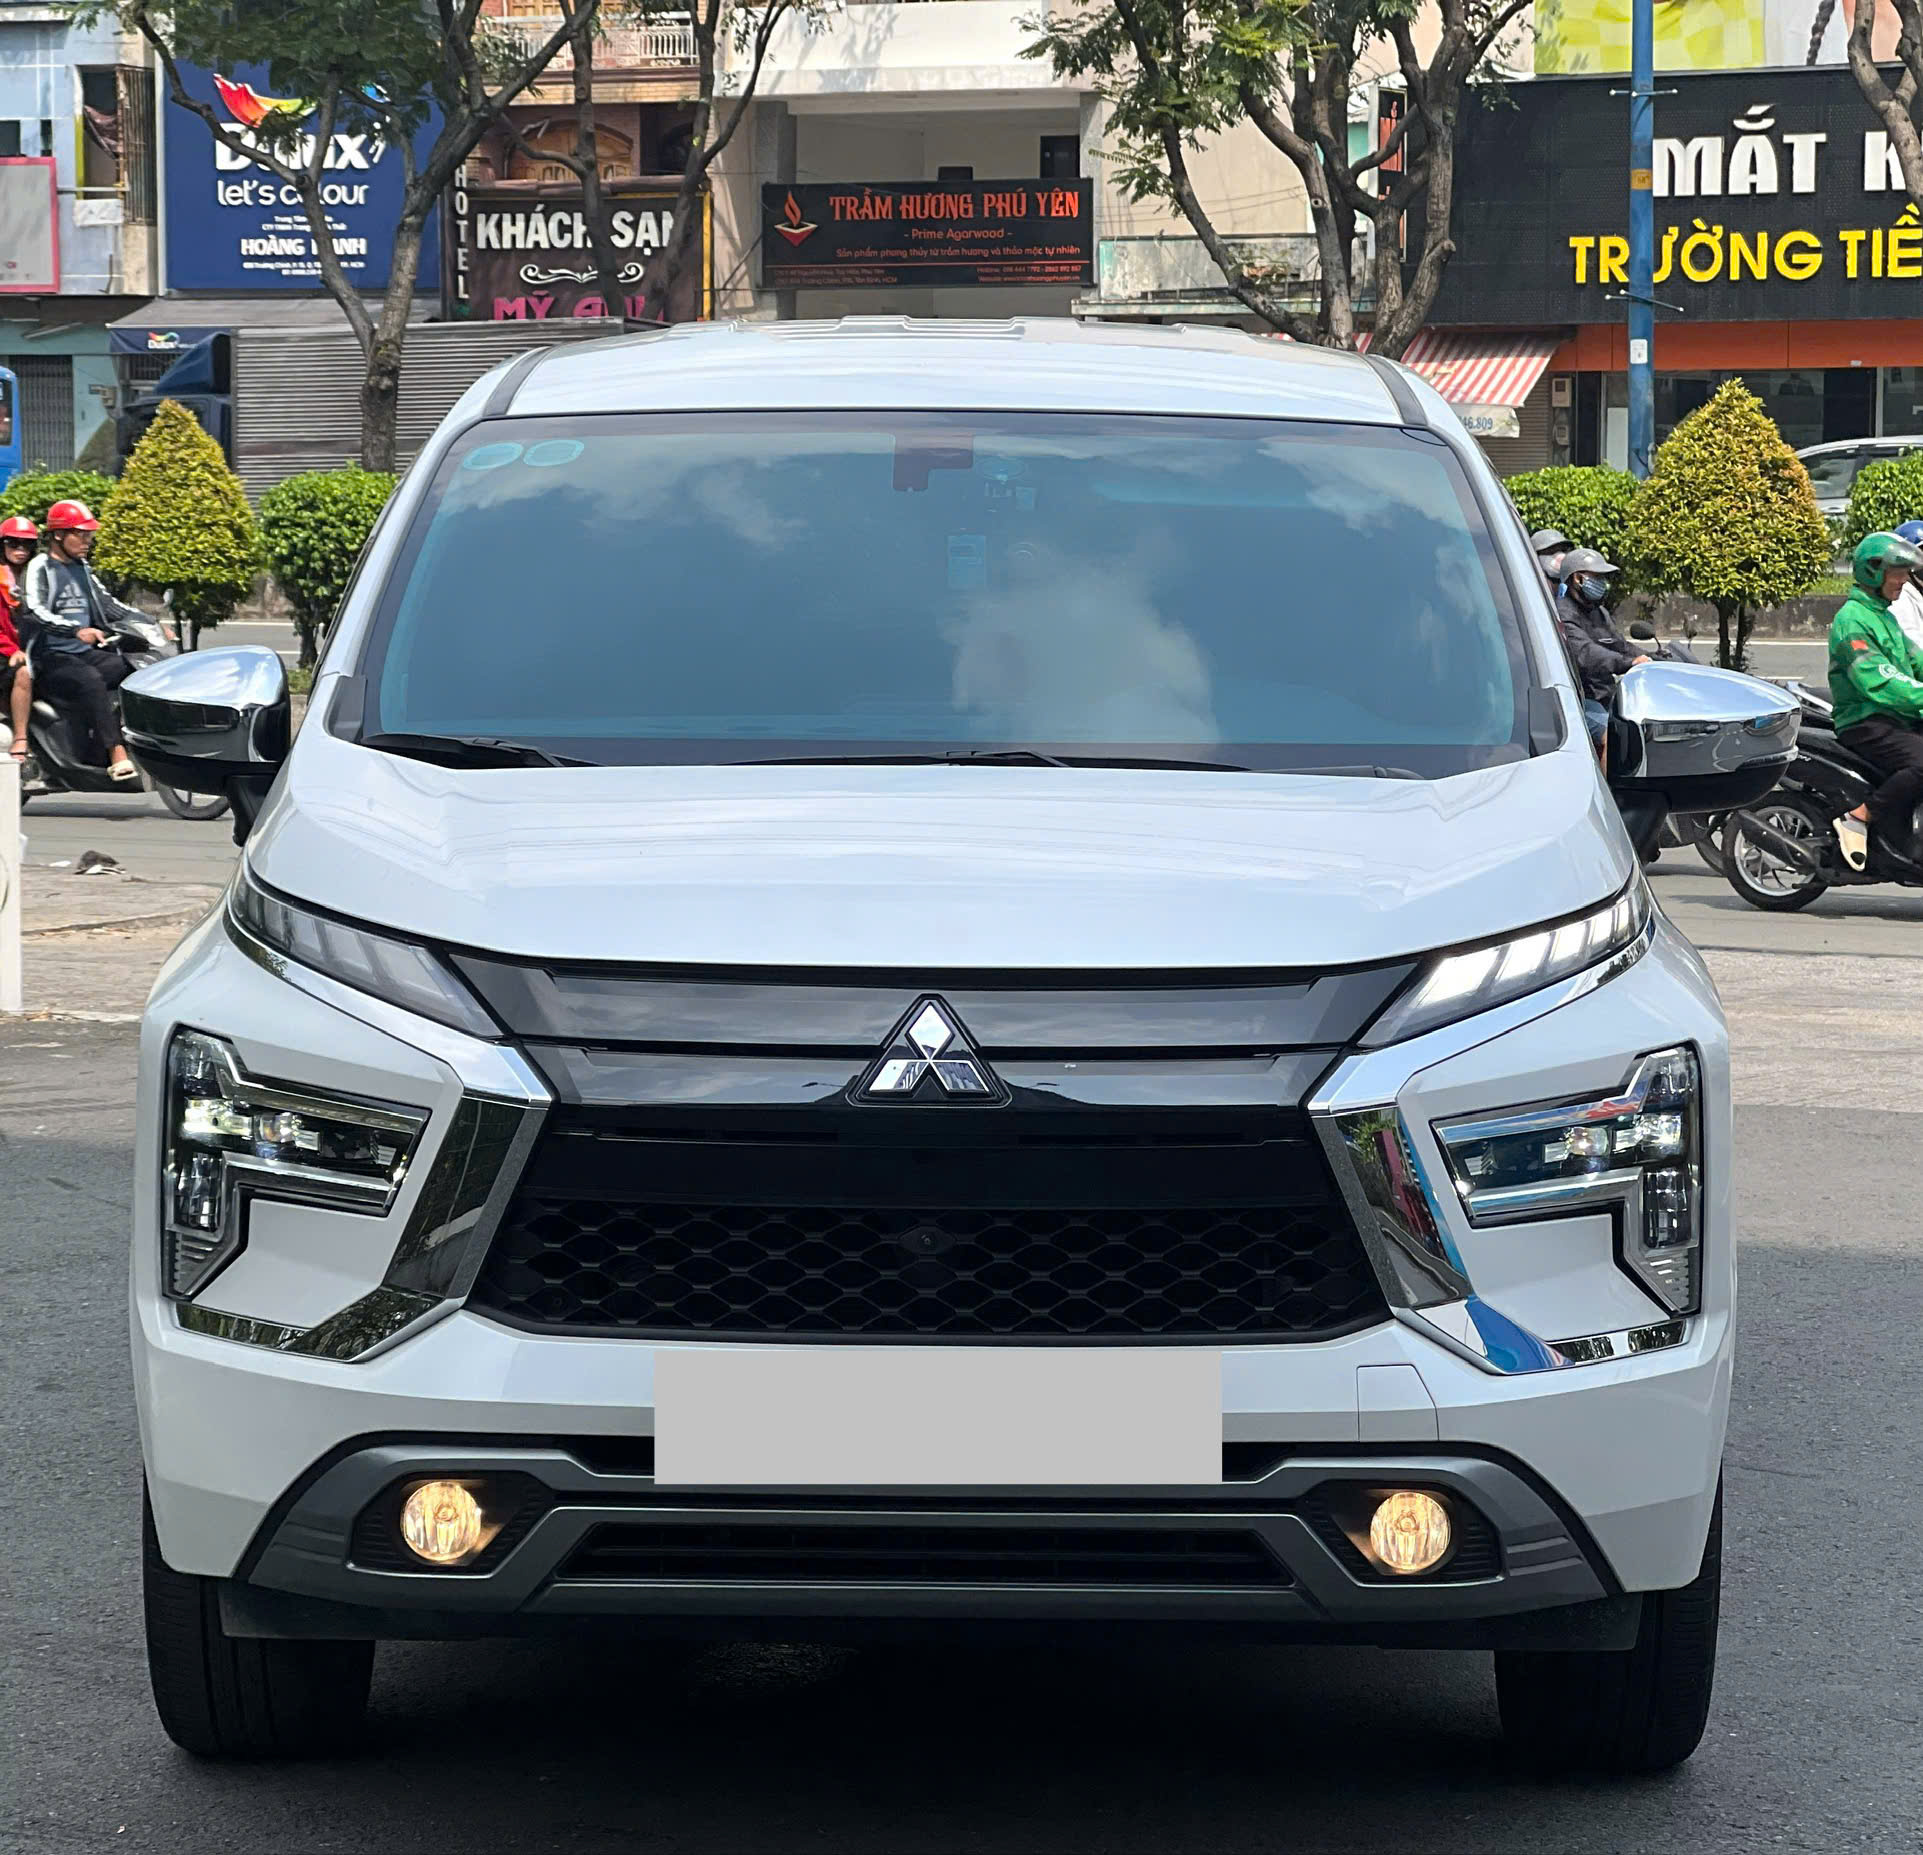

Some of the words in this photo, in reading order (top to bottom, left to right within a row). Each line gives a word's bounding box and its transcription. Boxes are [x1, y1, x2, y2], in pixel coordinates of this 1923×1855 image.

[1652, 103, 1827, 197] MẮT
[477, 203, 593, 249] KHÁCH
[983, 187, 1027, 219] PHÚ
[1035, 187, 1079, 219] YÊN
[240, 234, 305, 255] HOÀNG
[455, 164, 469, 299] HOTEL
[911, 228, 944, 240] Prime
[946, 228, 1005, 241] Agarwood
[1569, 217, 1823, 284] TRƯỜNG
